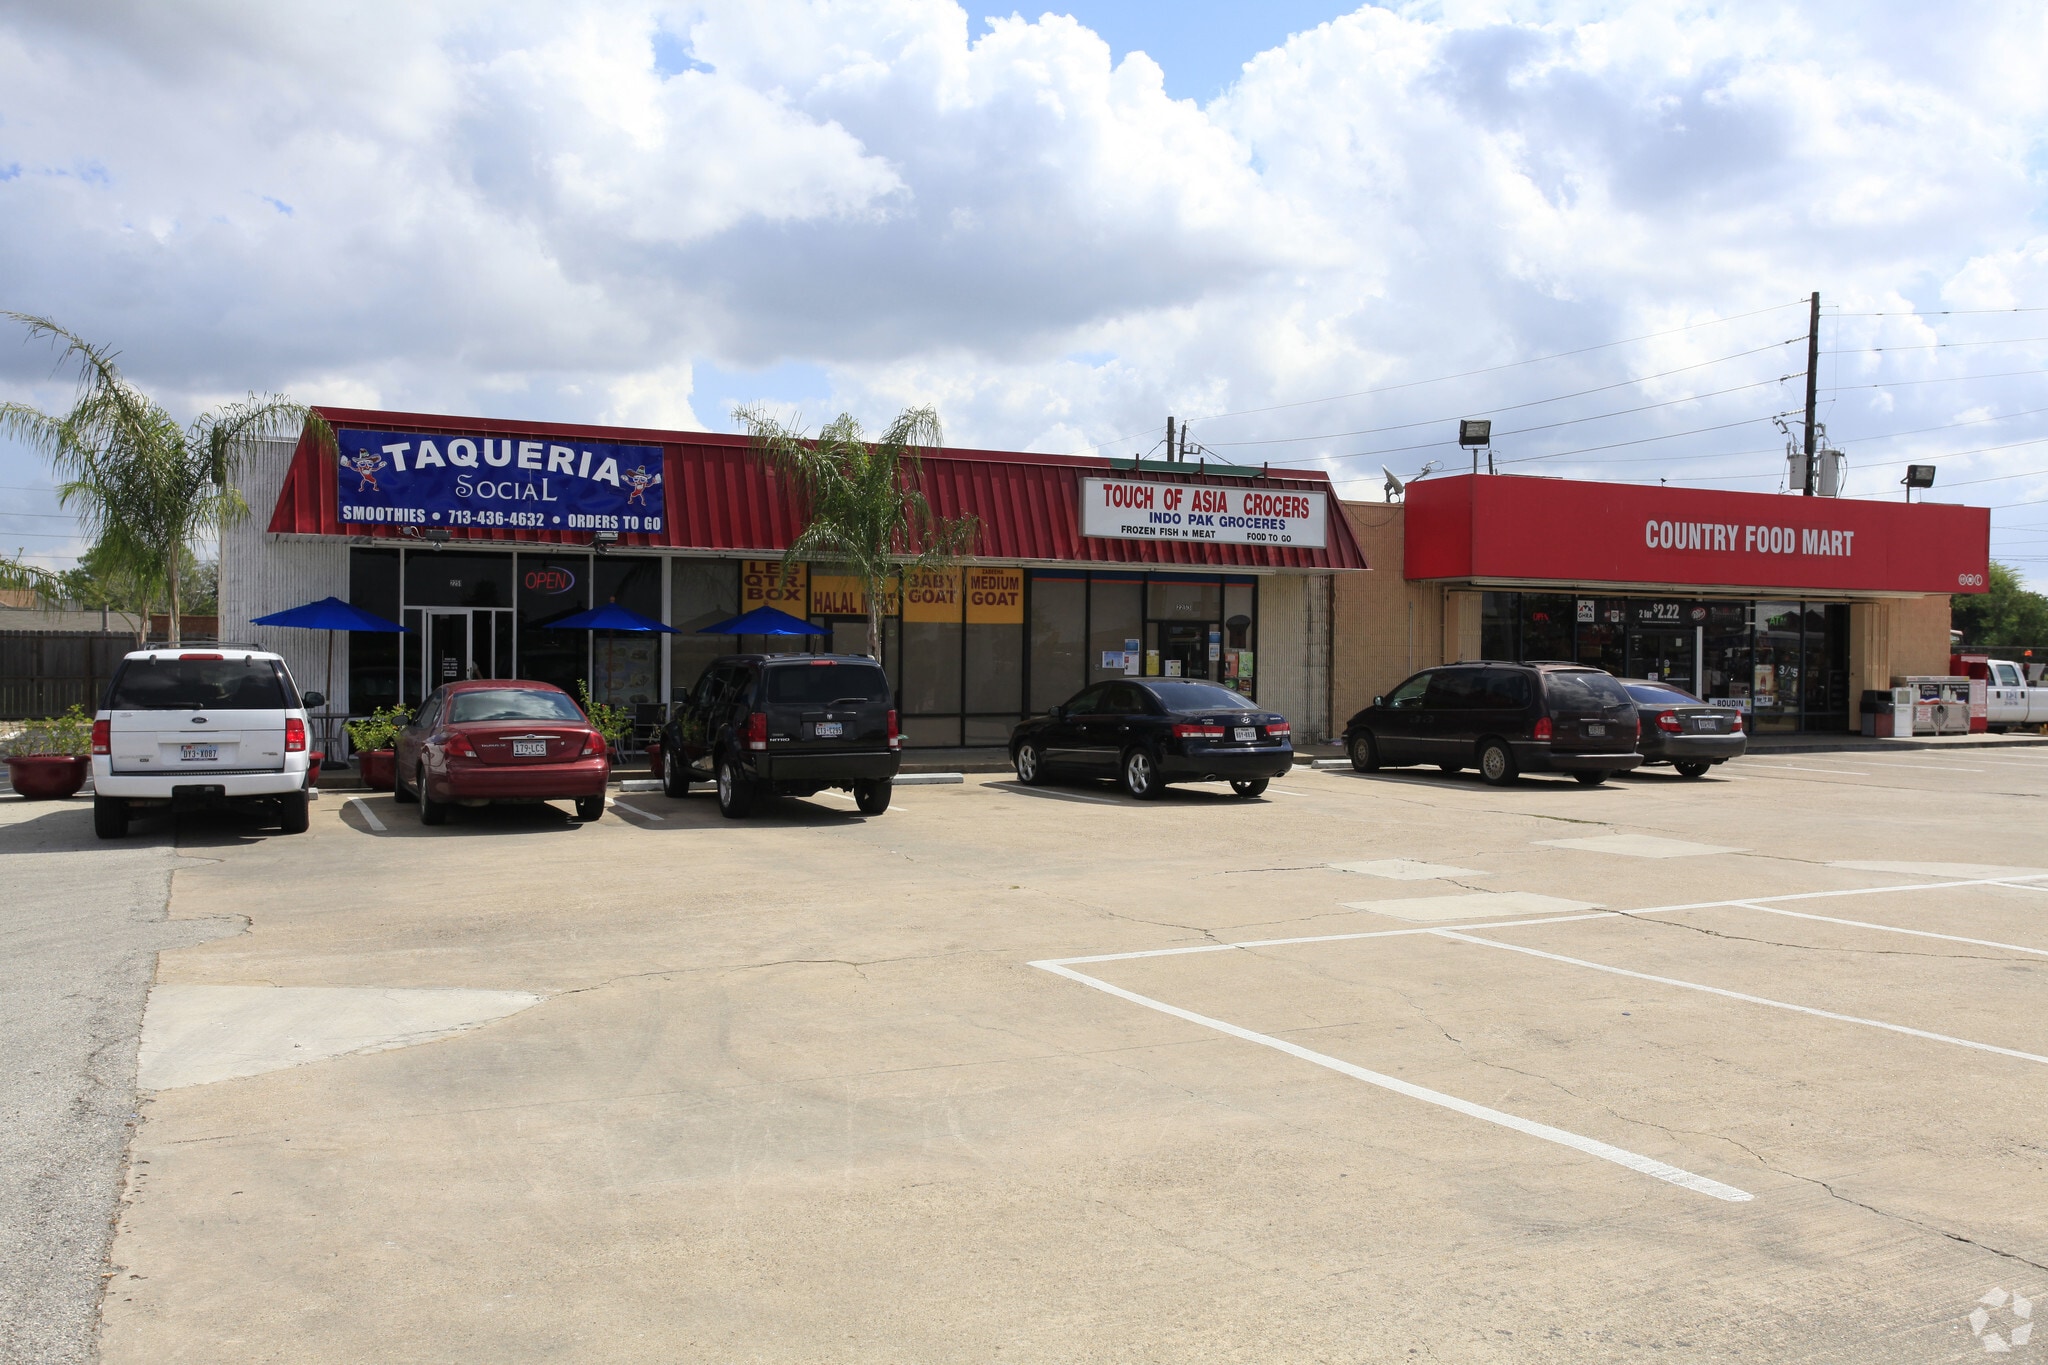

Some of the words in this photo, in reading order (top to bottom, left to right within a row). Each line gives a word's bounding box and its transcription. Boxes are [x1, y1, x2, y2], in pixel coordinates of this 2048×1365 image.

[382, 438, 620, 487] TAQUERIA
[1103, 484, 1154, 509] TOUCH
[1163, 488, 1183, 511] OF
[1191, 490, 1228, 513] ASIA
[1243, 493, 1310, 519] GROCERS
[342, 505, 426, 523] SMOOTHIES
[448, 509, 544, 527] 713-436-4632
[568, 513, 618, 529] ORDERS
[622, 515, 639, 530] TO
[644, 516, 661, 531] GO
[1149, 511, 1182, 525] INDO
[1188, 514, 1214, 526] PAK
[1219, 515, 1286, 531] GROCERES
[1121, 525, 1156, 535] FROZEN
[1159, 527, 1179, 537] FISH
[1192, 529, 1216, 539] MEAT
[1246, 532, 1267, 542] FOOD
[1268, 533, 1278, 542] TO
[1281, 534, 1292, 543] GO
[1645, 519, 1739, 551] COUNTRY
[1745, 525, 1796, 554] FOOD
[1802, 529, 1854, 557] MART
[525, 572, 567, 589] OPEN
[744, 574, 806, 588] QTR.
[909, 574, 957, 588] BABY
[971, 576, 1019, 590] MEDIUM
[747, 588, 801, 601] BOX
[814, 591, 857, 613] HALAL
[908, 589, 957, 604] GOAT
[971, 591, 1019, 606] GOAT
[1653, 603, 1680, 619] $2.22
